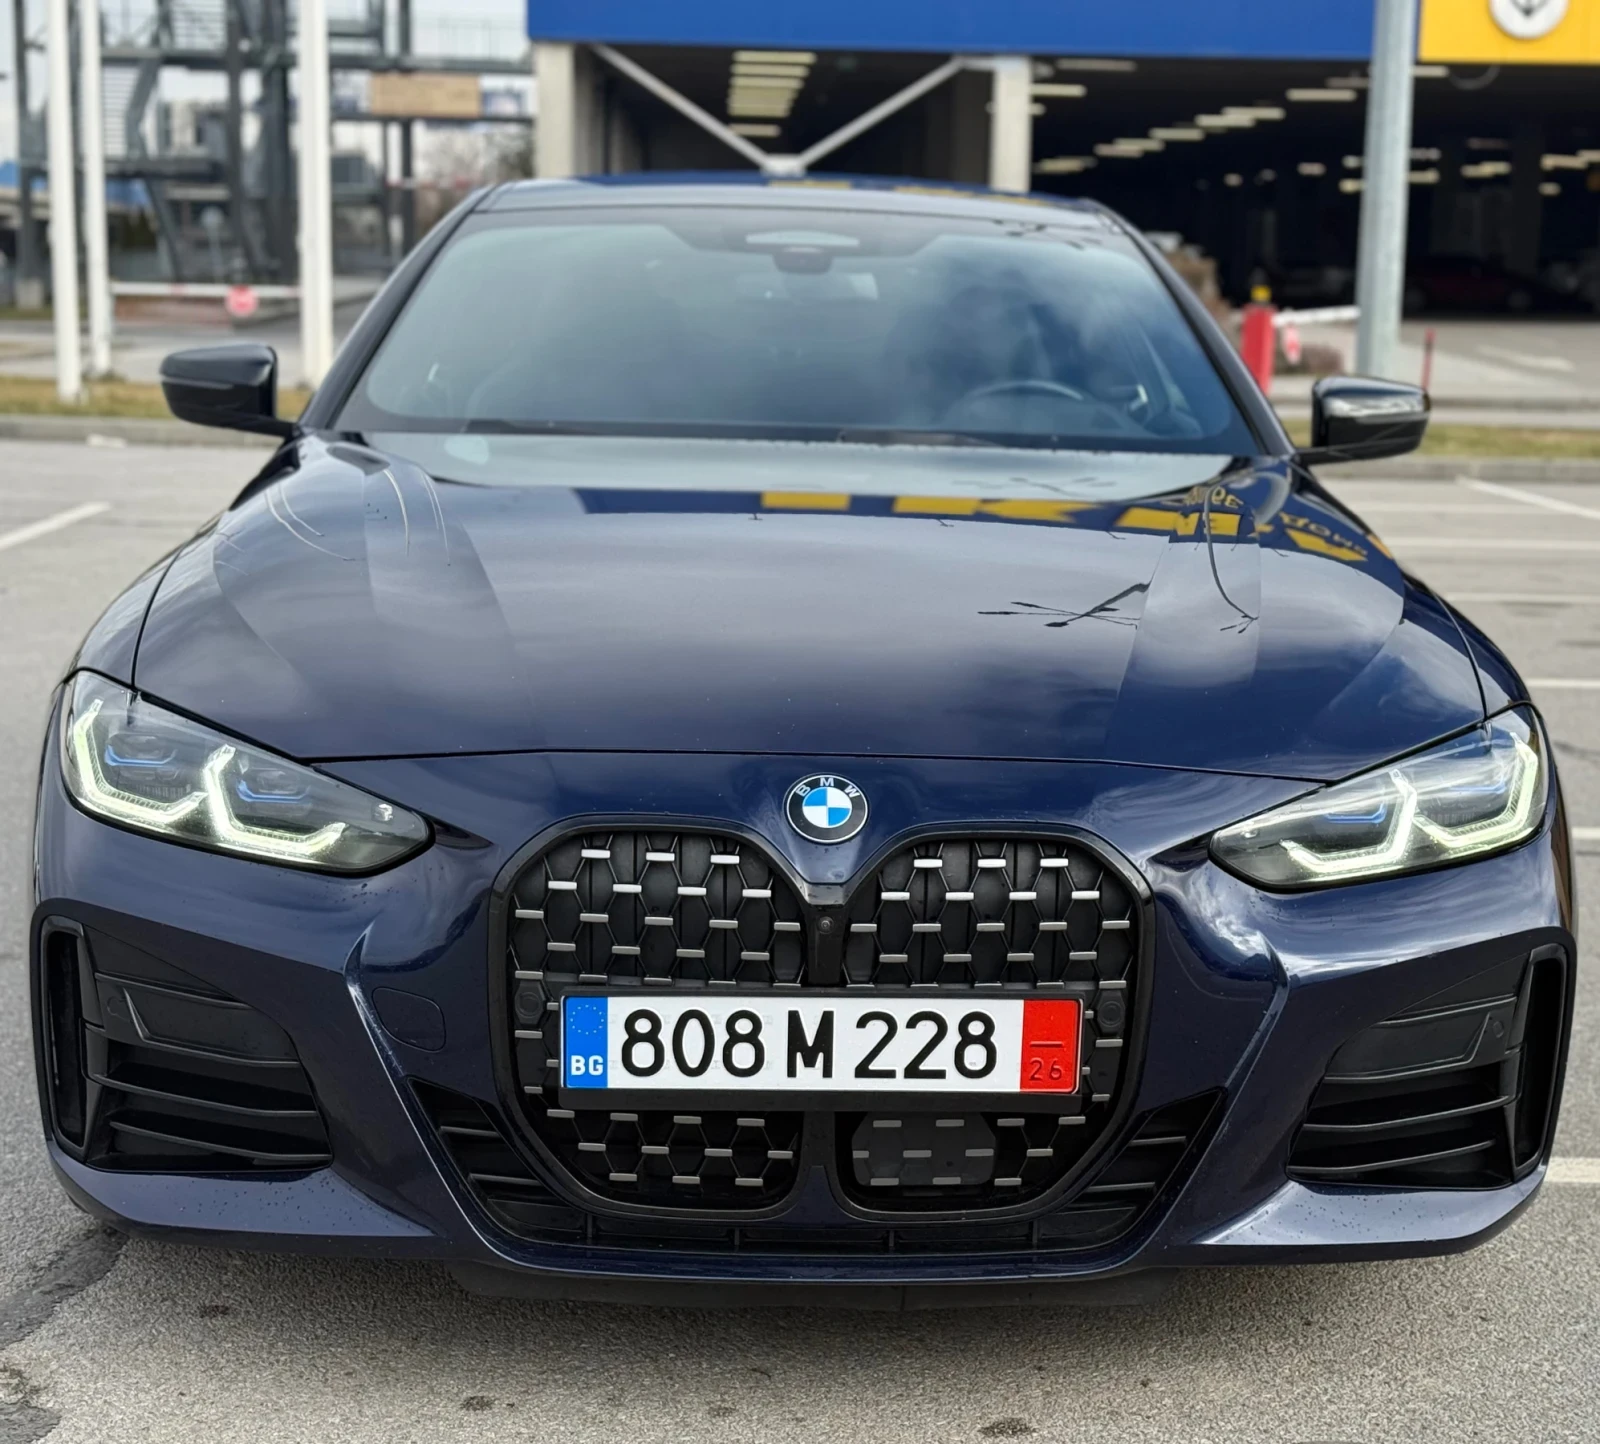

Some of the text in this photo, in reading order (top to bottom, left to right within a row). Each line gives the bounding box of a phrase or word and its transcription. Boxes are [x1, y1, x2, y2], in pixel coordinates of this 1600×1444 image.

[795, 777, 860, 798] BMW
[621, 1008, 997, 1080] 808 M 228
[571, 1055, 604, 1076] BG
[1029, 1057, 1063, 1081] 26
